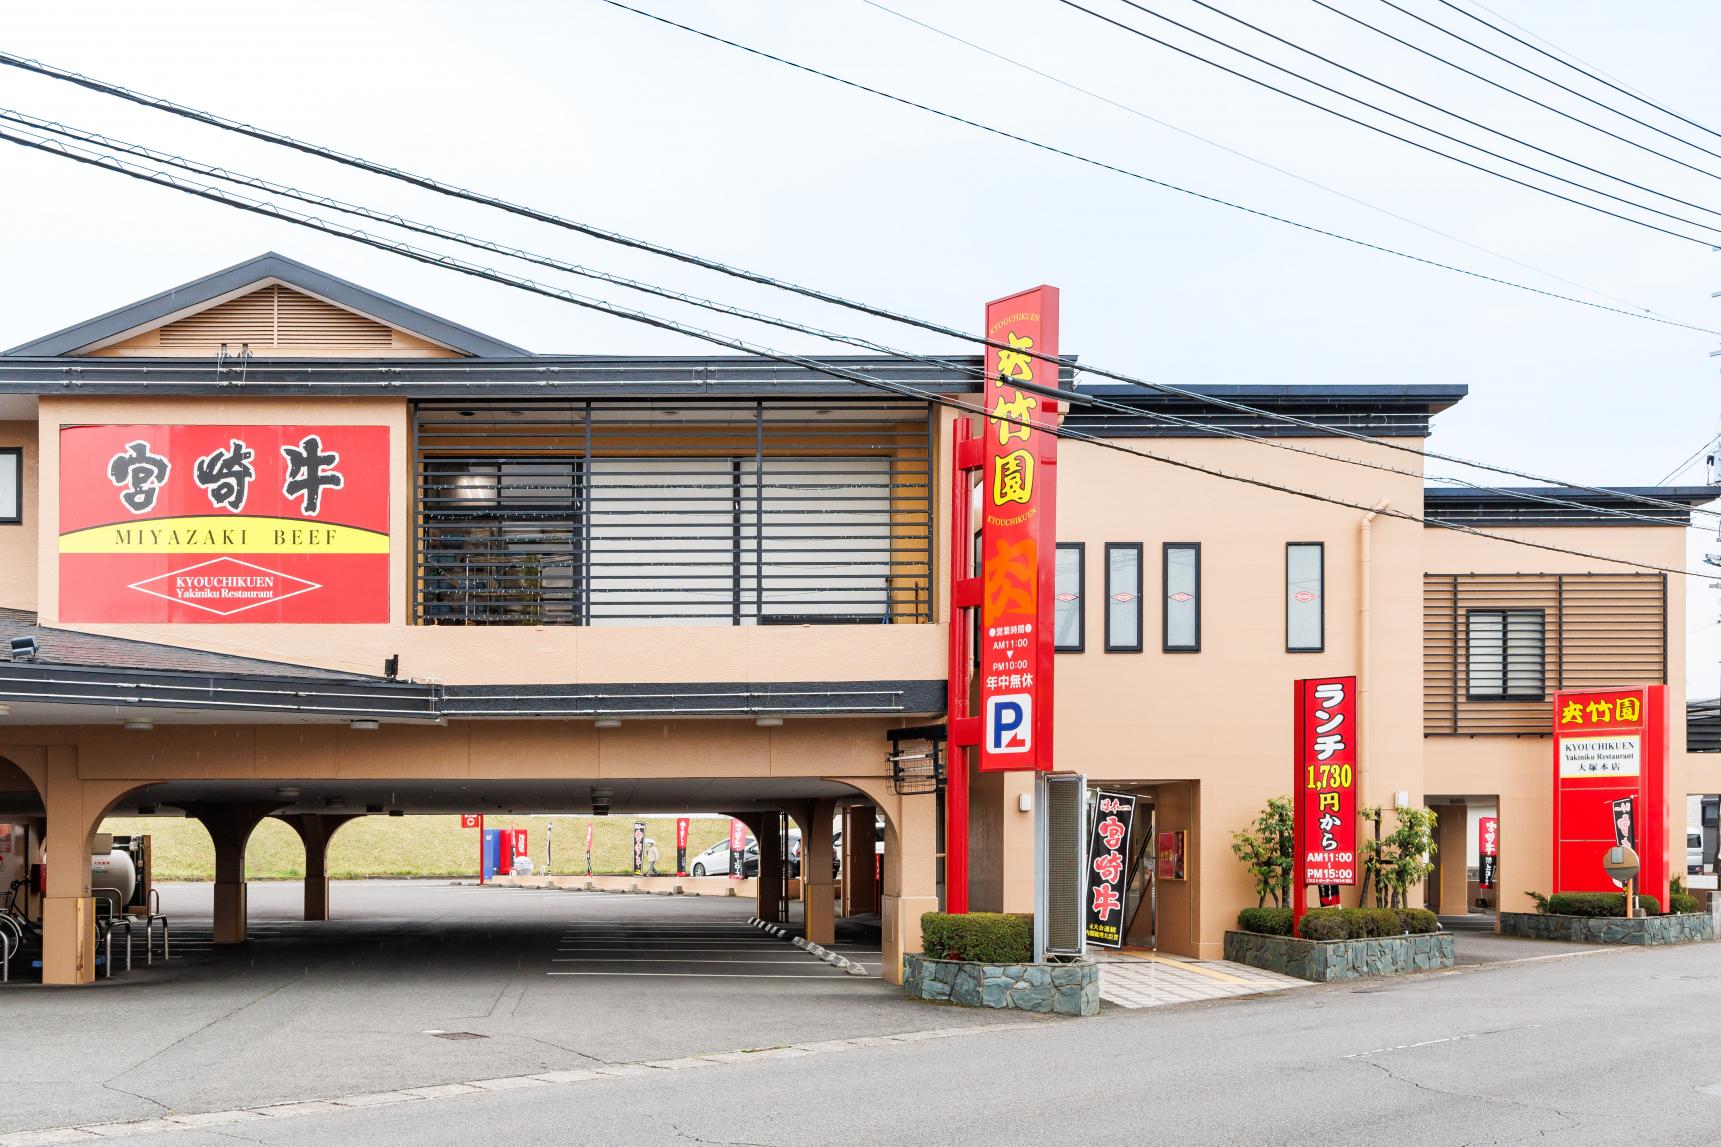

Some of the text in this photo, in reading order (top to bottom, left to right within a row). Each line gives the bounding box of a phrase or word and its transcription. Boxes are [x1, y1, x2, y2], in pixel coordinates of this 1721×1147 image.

[108, 434, 344, 516] 宮崎牛
[115, 529, 338, 545] MIYAZAKI BEEF
[176, 576, 275, 588] KYOUCHIKUEN
[176, 588, 274, 598] Yakiniku Restaurant
[993, 638, 1028, 650] AM11:00
[993, 660, 1028, 671] PM10:00
[986, 673, 1033, 691] 年中無休
[994, 701, 1024, 749] P
[1314, 682, 1345, 761] ランチ
[1565, 741, 1634, 751] KYOUCHIKUEN
[1307, 764, 1352, 790] 1,730
[1100, 798, 1131, 814] 日本一
[1307, 853, 1352, 862] AM11:00
[1092, 816, 1126, 921] 宮崎牛
[1307, 869, 1352, 878] PM15:00
